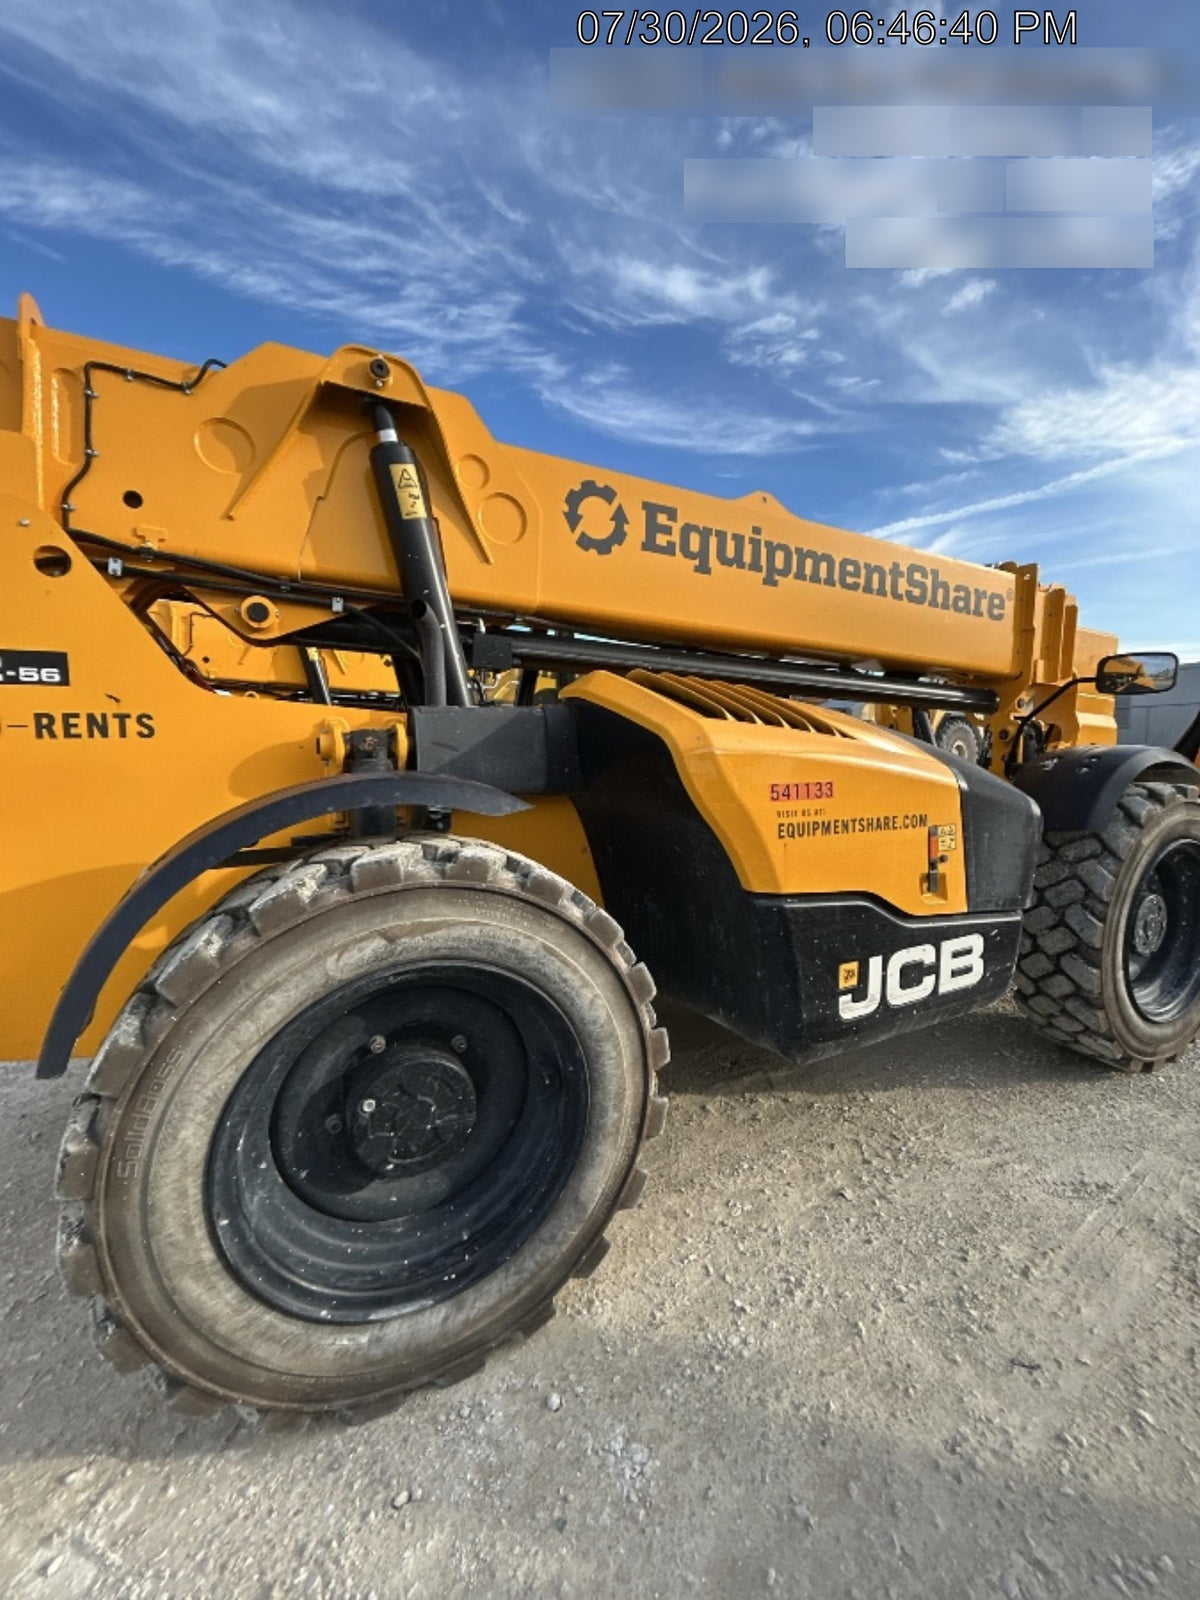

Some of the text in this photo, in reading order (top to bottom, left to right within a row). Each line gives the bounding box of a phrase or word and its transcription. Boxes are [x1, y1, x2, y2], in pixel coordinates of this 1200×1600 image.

[641, 500, 1005, 622] EquipmentShare
[0, 656, 61, 682] -56
[770, 781, 833, 801] 541133
[778, 814, 928, 839] EQUIPMENTSHARE.COM
[838, 933, 985, 1020] JCB
